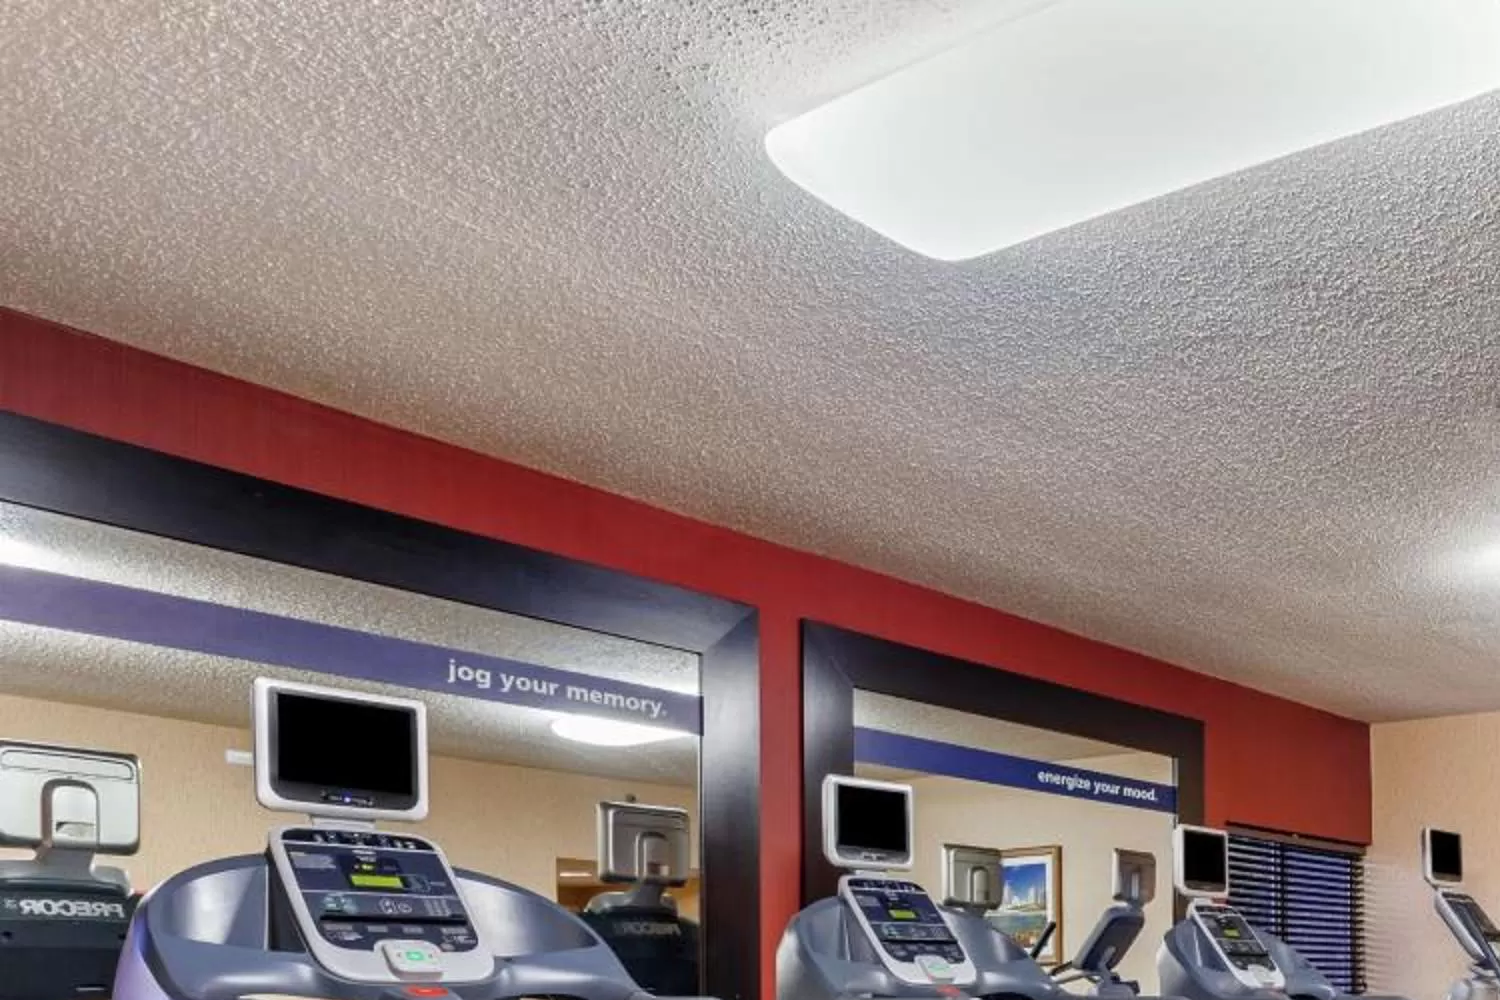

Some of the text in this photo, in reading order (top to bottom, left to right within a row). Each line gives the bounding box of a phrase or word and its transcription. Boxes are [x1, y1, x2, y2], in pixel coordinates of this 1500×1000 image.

[447, 658, 668, 719] jog your memory.
[1037, 771, 1159, 801] energize your mood.
